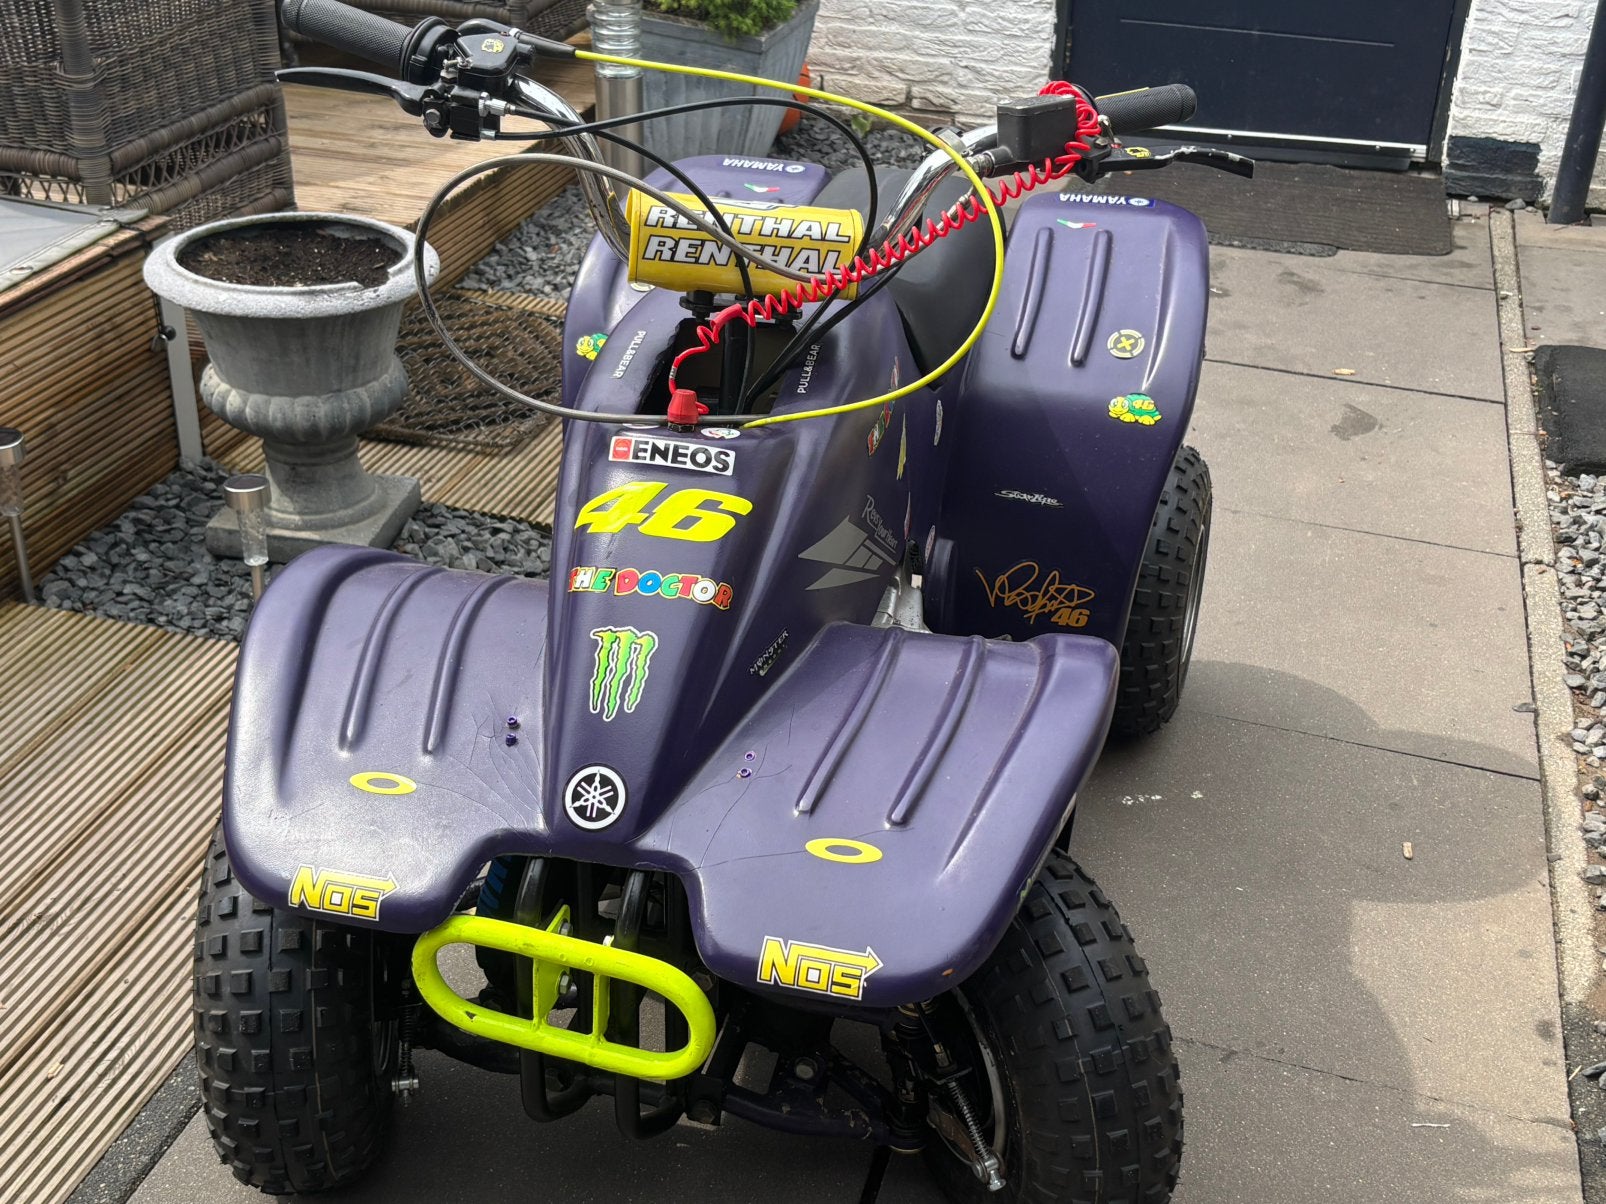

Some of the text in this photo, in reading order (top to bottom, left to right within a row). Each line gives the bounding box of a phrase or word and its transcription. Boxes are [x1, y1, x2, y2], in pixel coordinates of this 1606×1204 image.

[723, 158, 784, 171] YAMAHA
[1059, 193, 1127, 205] YAMAHA
[612, 330, 647, 379] PULL&BEAR
[797, 344, 821, 394] PULL&BEAR
[631, 439, 732, 473] ENEOS
[575, 481, 753, 542] 46
[614, 568, 733, 610] DOCTOR
[1050, 607, 1090, 627] 46
[749, 629, 789, 676] MONSTER
[289, 864, 400, 921] NOS
[757, 935, 884, 1000] NOS
